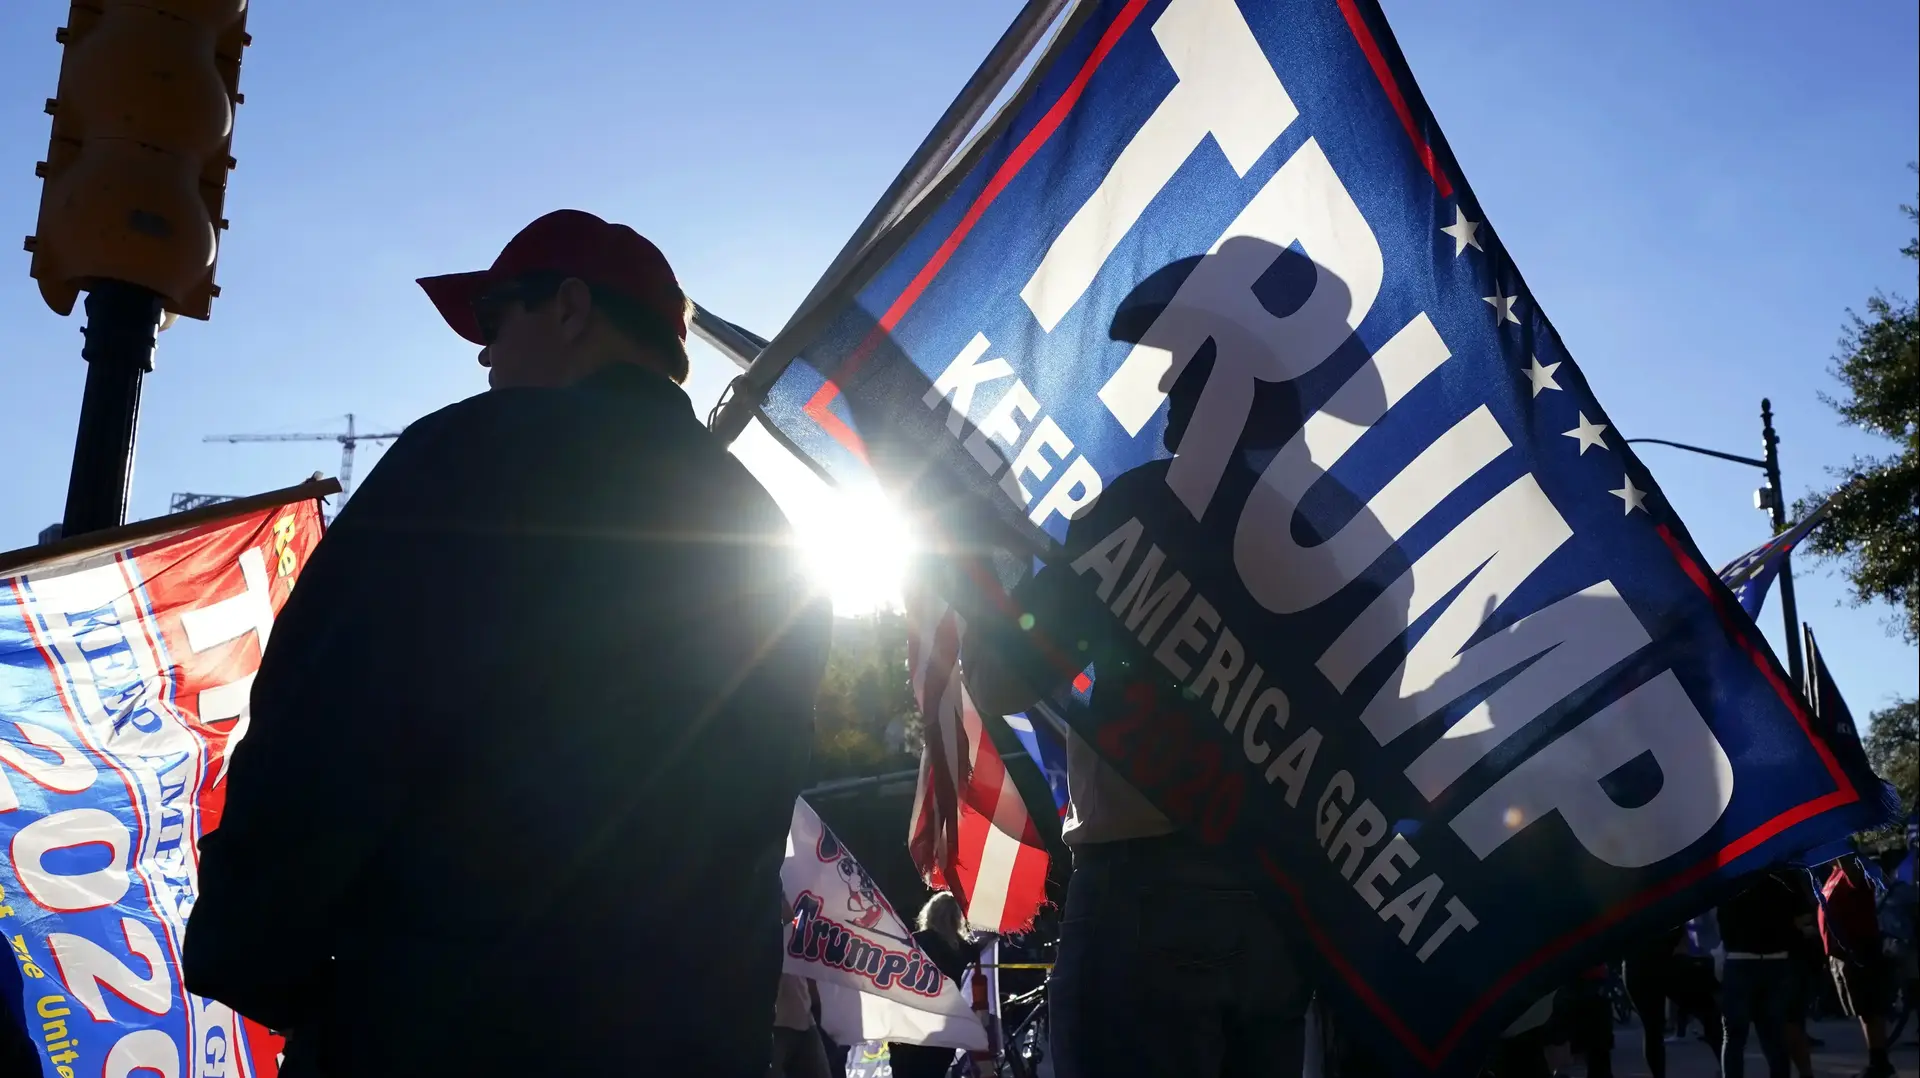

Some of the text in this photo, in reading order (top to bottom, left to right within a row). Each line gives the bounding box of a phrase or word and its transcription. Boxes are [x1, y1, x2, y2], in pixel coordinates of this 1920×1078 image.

[1019, 0, 1734, 869] TRUMP
[64, 603, 163, 736] KEEP
[922, 331, 1479, 963] KEEP AMERICA GREAT
[1097, 682, 1245, 845] 2020
[787, 890, 946, 997] Trumpin
